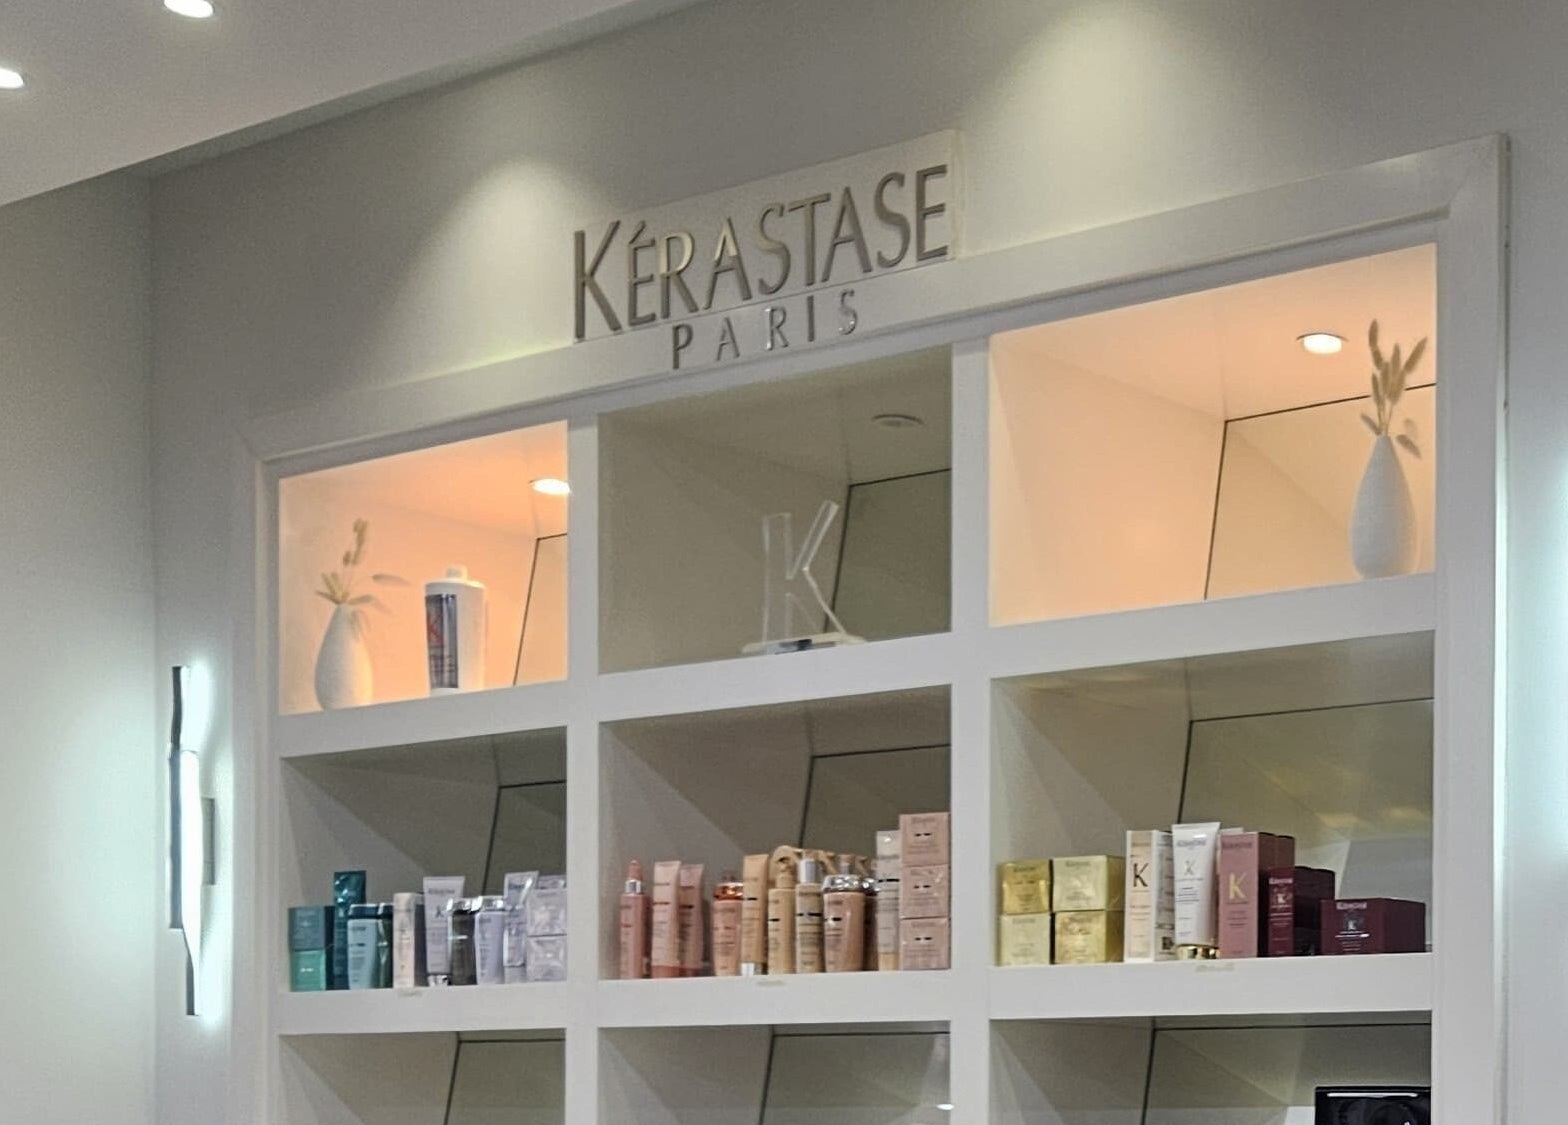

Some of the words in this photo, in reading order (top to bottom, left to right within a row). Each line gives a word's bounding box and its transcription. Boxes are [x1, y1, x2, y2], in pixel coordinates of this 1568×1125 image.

[574, 164, 949, 343] KÉRASTASE
[672, 288, 860, 370] PARIS
[1229, 873, 1247, 899] K
